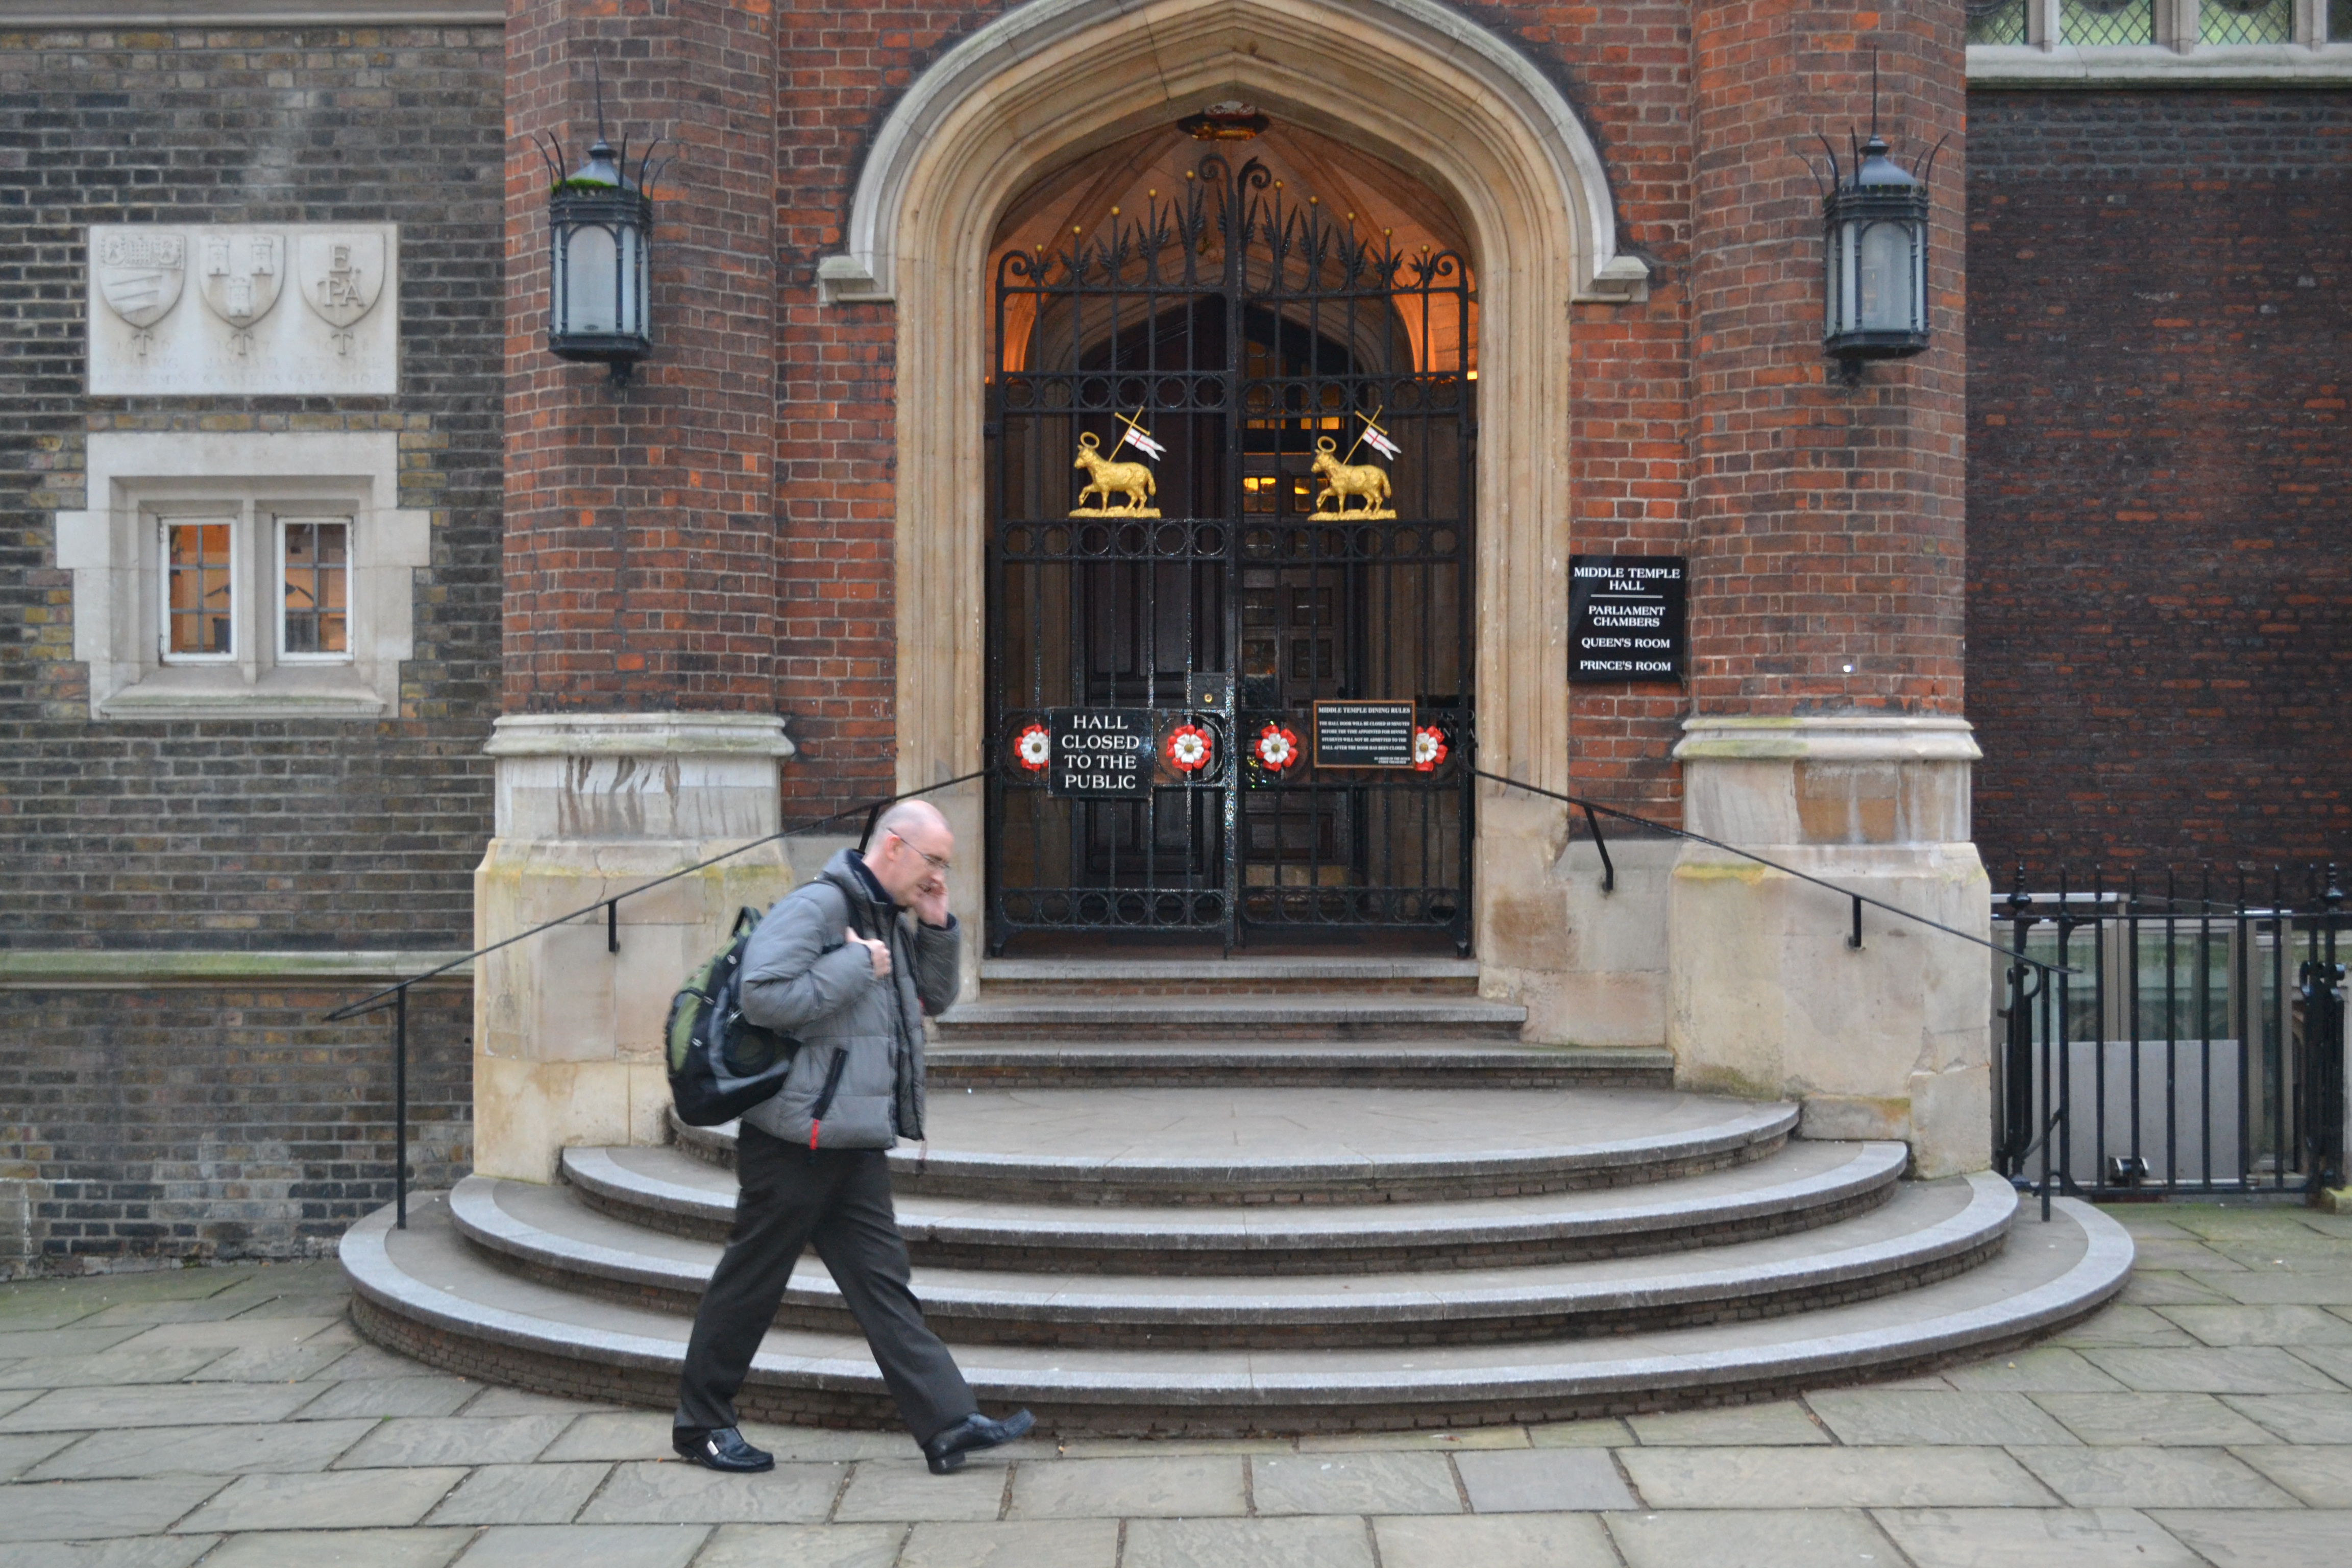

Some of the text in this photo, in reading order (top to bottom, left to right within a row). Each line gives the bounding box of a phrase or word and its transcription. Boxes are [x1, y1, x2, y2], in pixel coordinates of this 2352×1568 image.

[1574, 567, 1680, 578] MIDDLE TEMPLE
[1609, 580, 1645, 591] HALL
[1588, 605, 1665, 616] PARLIAMENT
[1593, 617, 1660, 627] CHAMBERS
[1581, 638, 1670, 649] QUEEN'S ROOM
[1580, 660, 1671, 671] PRINCE'S ROOM
[1073, 715, 1128, 729] HALL
[1062, 734, 1139, 749] CLOSED
[1064, 754, 1137, 769] TO THE
[1065, 774, 1136, 789] PUBLIC
